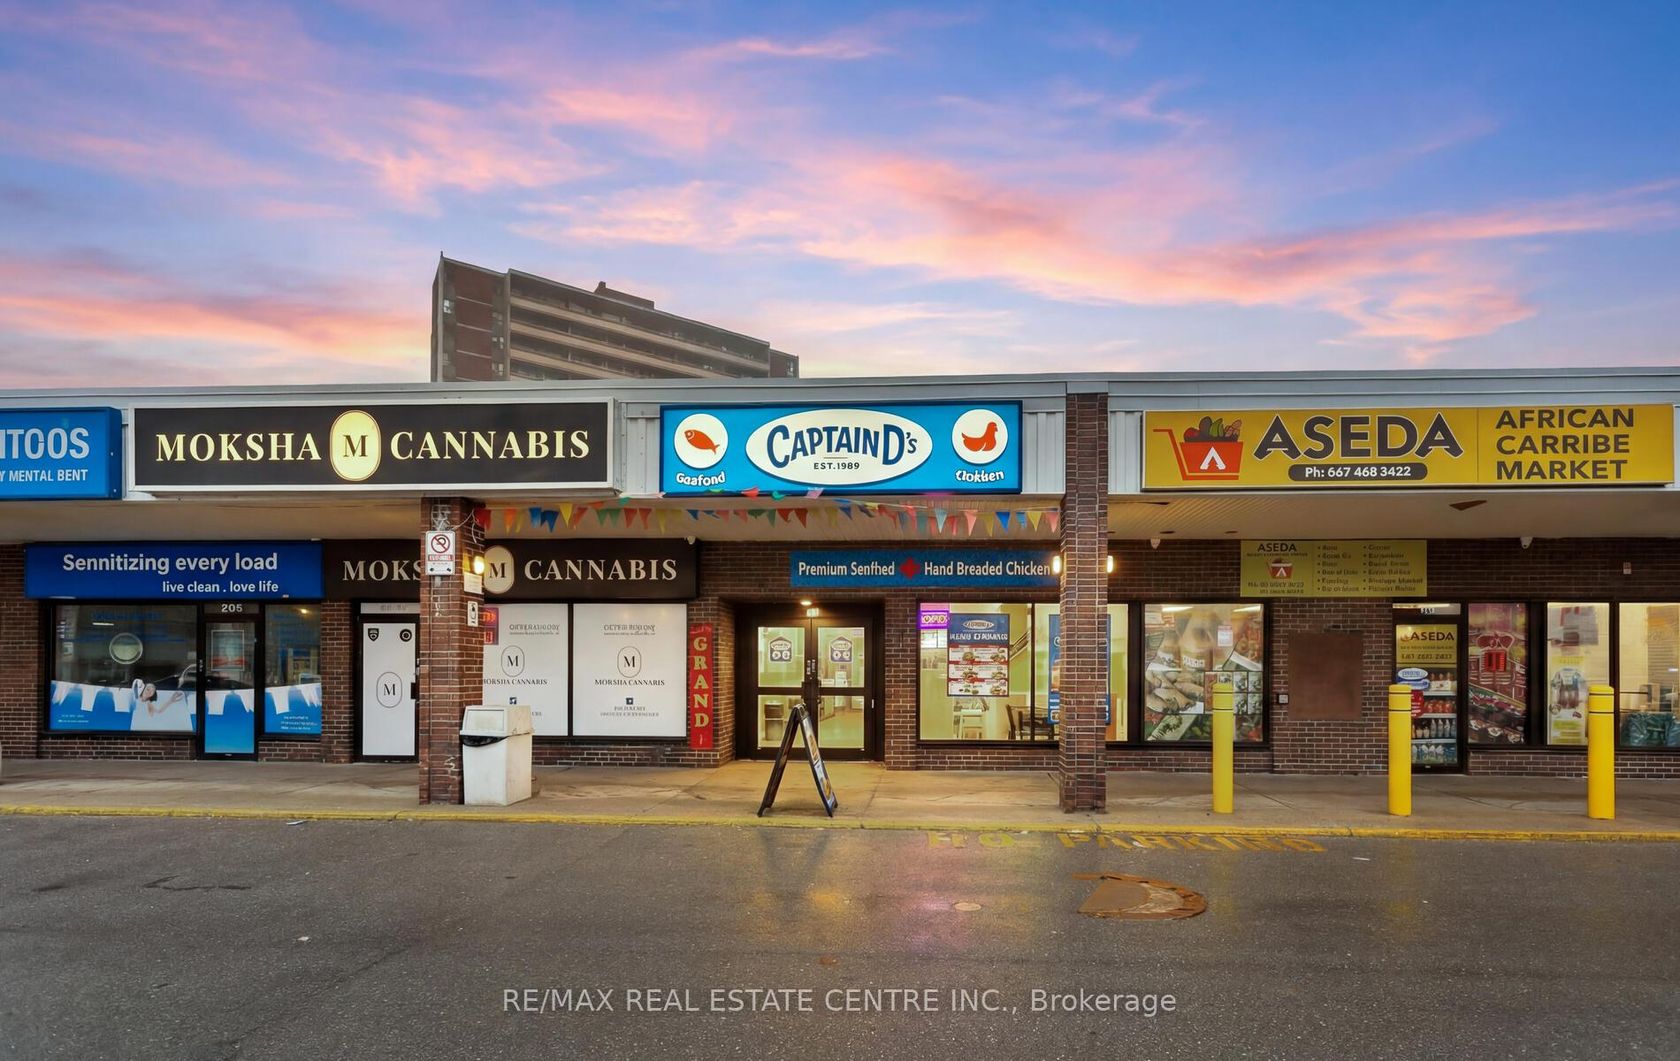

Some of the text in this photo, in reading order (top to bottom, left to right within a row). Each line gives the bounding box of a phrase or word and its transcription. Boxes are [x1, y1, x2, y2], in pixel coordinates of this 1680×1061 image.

[1495, 408, 1635, 430] AFRICAN
[1253, 411, 1465, 461] ASEDA
[156, 430, 590, 462] MOKSHA M CANNABIS
[1496, 434, 1631, 455] CARRIBE
[9, 470, 54, 482] MENTAL
[57, 469, 88, 481] BENT
[1305, 465, 1412, 479] Ph: 667 468 3422
[1496, 459, 1628, 480] MARKET
[1257, 543, 1297, 553] ASEDA
[62, 552, 278, 575] Sennitizing every load
[524, 558, 678, 582] CANNABIS
[798, 562, 847, 577] Premium
[924, 562, 954, 576] Hand
[957, 562, 1002, 576] Breaded
[1006, 562, 1051, 577] Chicken
[162, 581, 184, 592] live
[187, 581, 220, 592] clean
[229, 581, 255, 592] love
[258, 580, 279, 592] life
[221, 603, 243, 612] 205
[1410, 632, 1454, 641] ASEDA
[507, 655, 519, 668] M
[624, 655, 636, 668] M
[692, 636, 710, 728] GRAND
